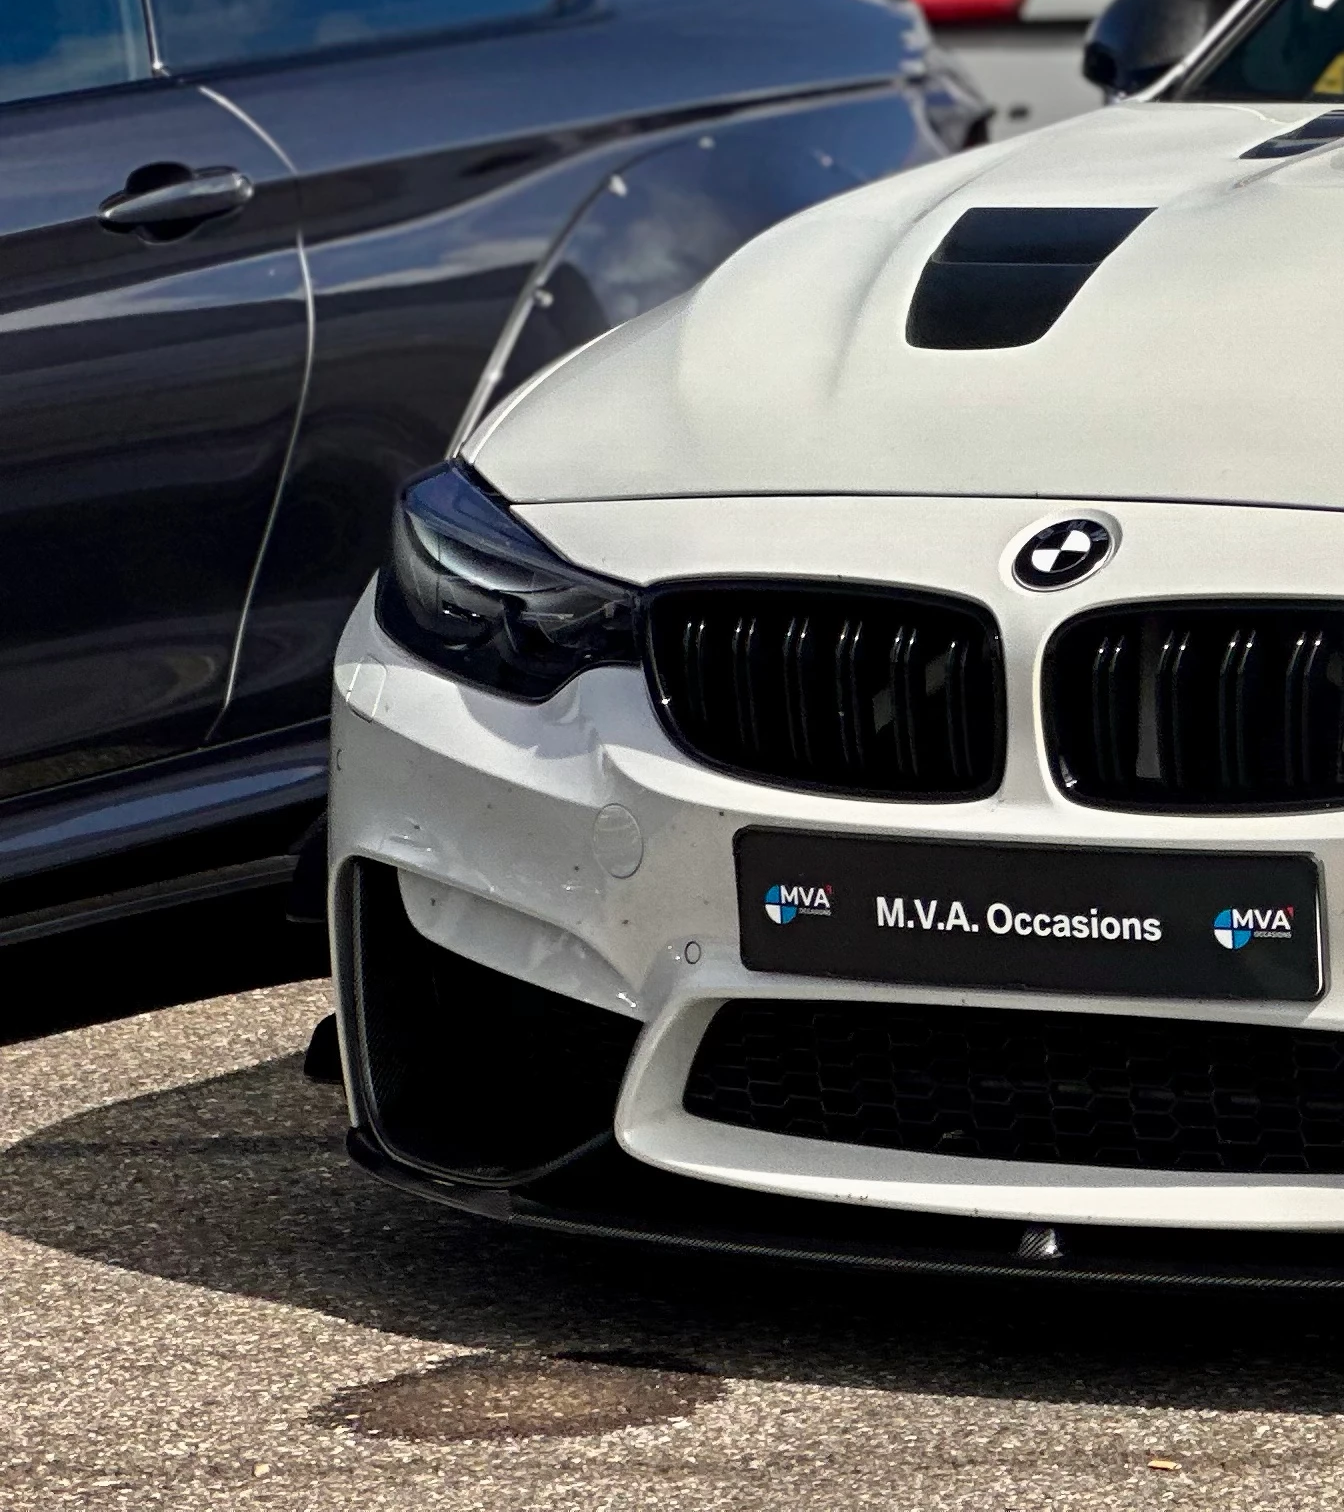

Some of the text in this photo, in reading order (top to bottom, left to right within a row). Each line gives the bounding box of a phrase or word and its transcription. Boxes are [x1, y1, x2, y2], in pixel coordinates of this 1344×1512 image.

[780, 884, 831, 908] MVA
[876, 896, 1162, 942] M.V.A. Occasions
[1232, 908, 1291, 930] MVA
